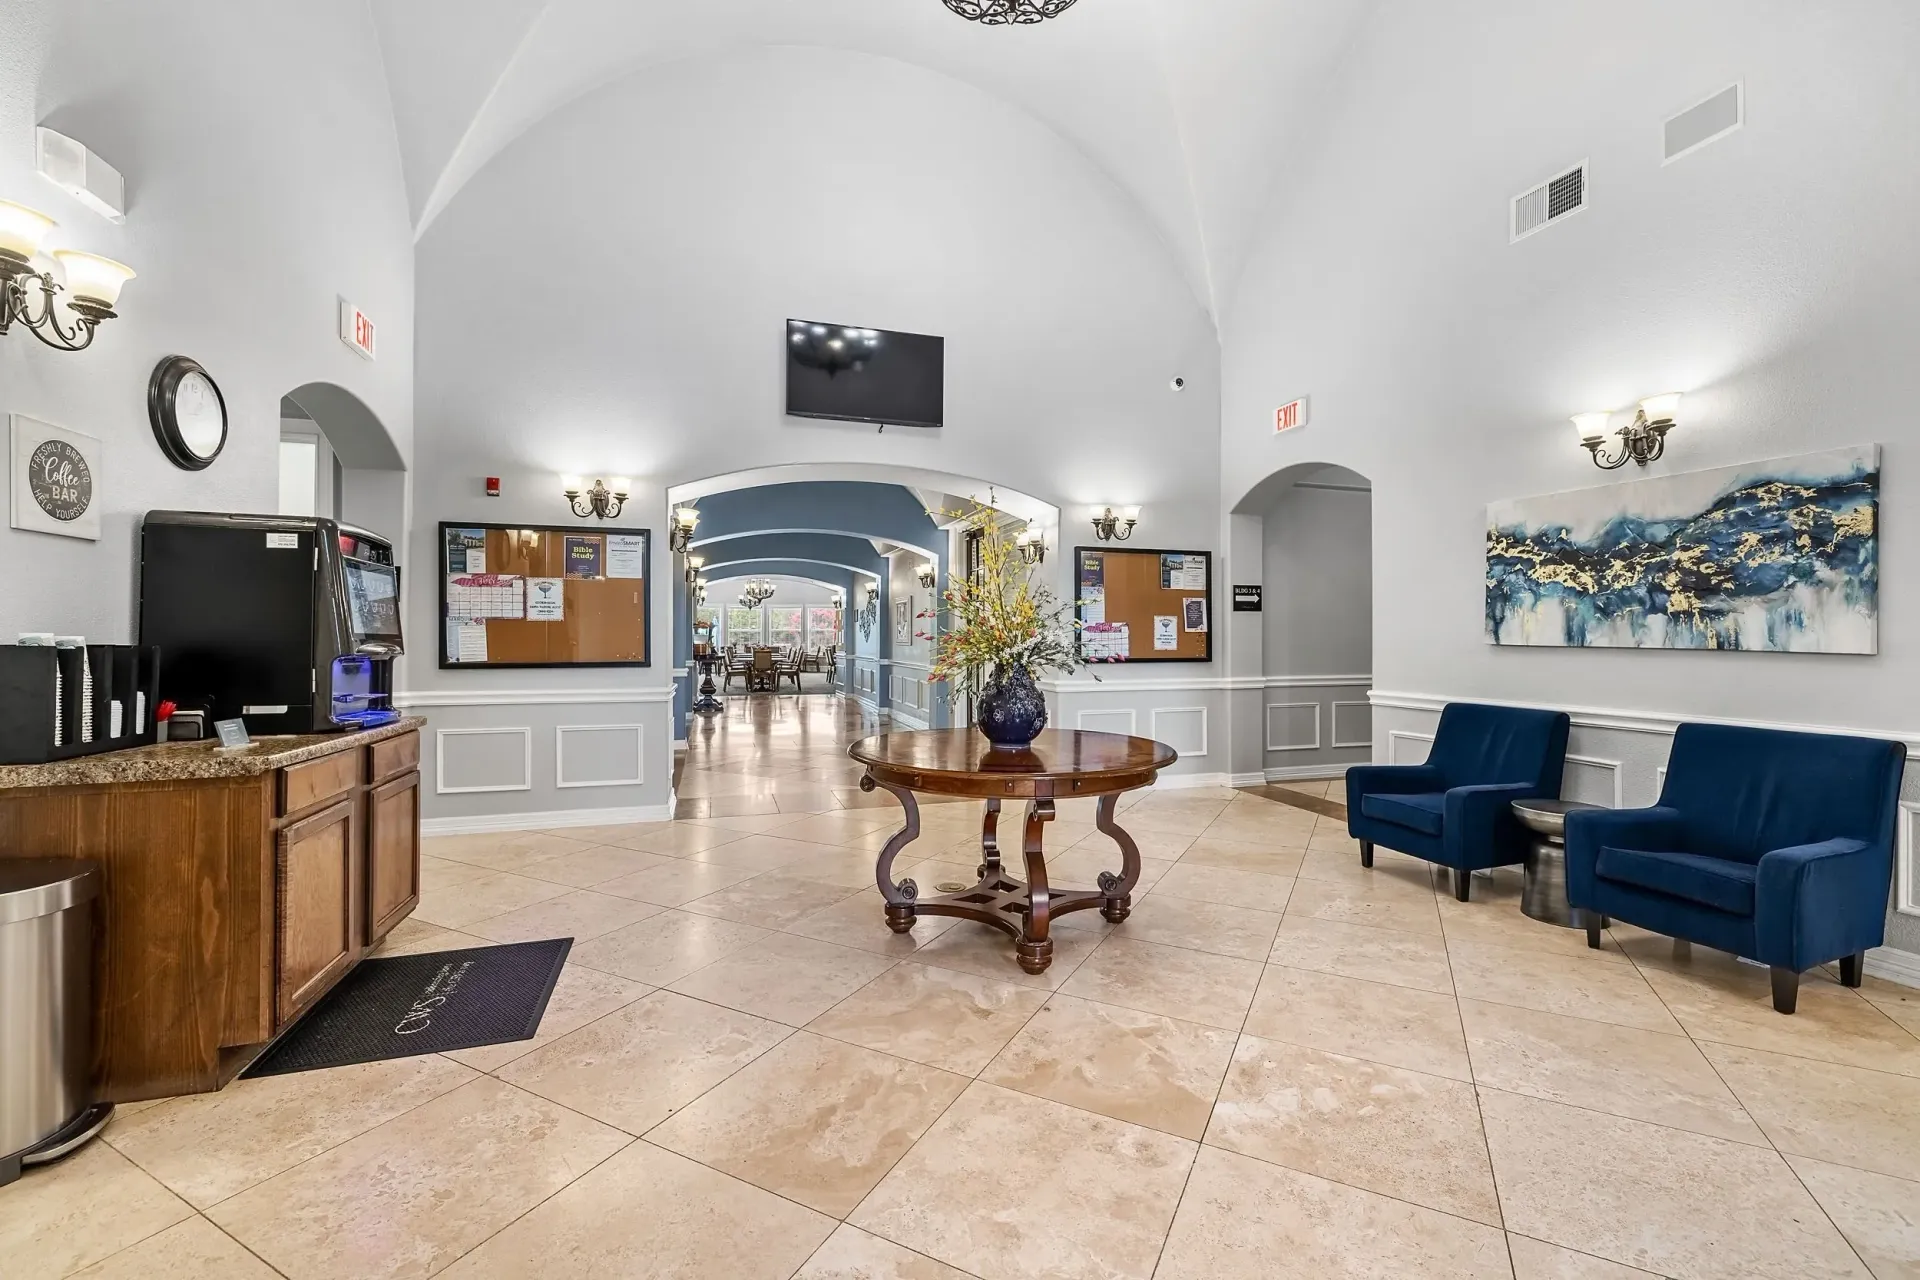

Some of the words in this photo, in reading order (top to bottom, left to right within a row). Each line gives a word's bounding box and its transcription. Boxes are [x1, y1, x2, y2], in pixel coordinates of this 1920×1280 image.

[356, 311, 374, 354] EXIT
[1277, 402, 1298, 431] EXIT
[31, 443, 63, 471] FRESHLY
[66, 447, 91, 483] BREWED
[42, 456, 80, 487] Coffee
[34, 489, 53, 511] HELP
[55, 496, 89, 520] YOURSELF
[52, 486, 78, 503] BAR
[571, 553, 595, 561] Study
